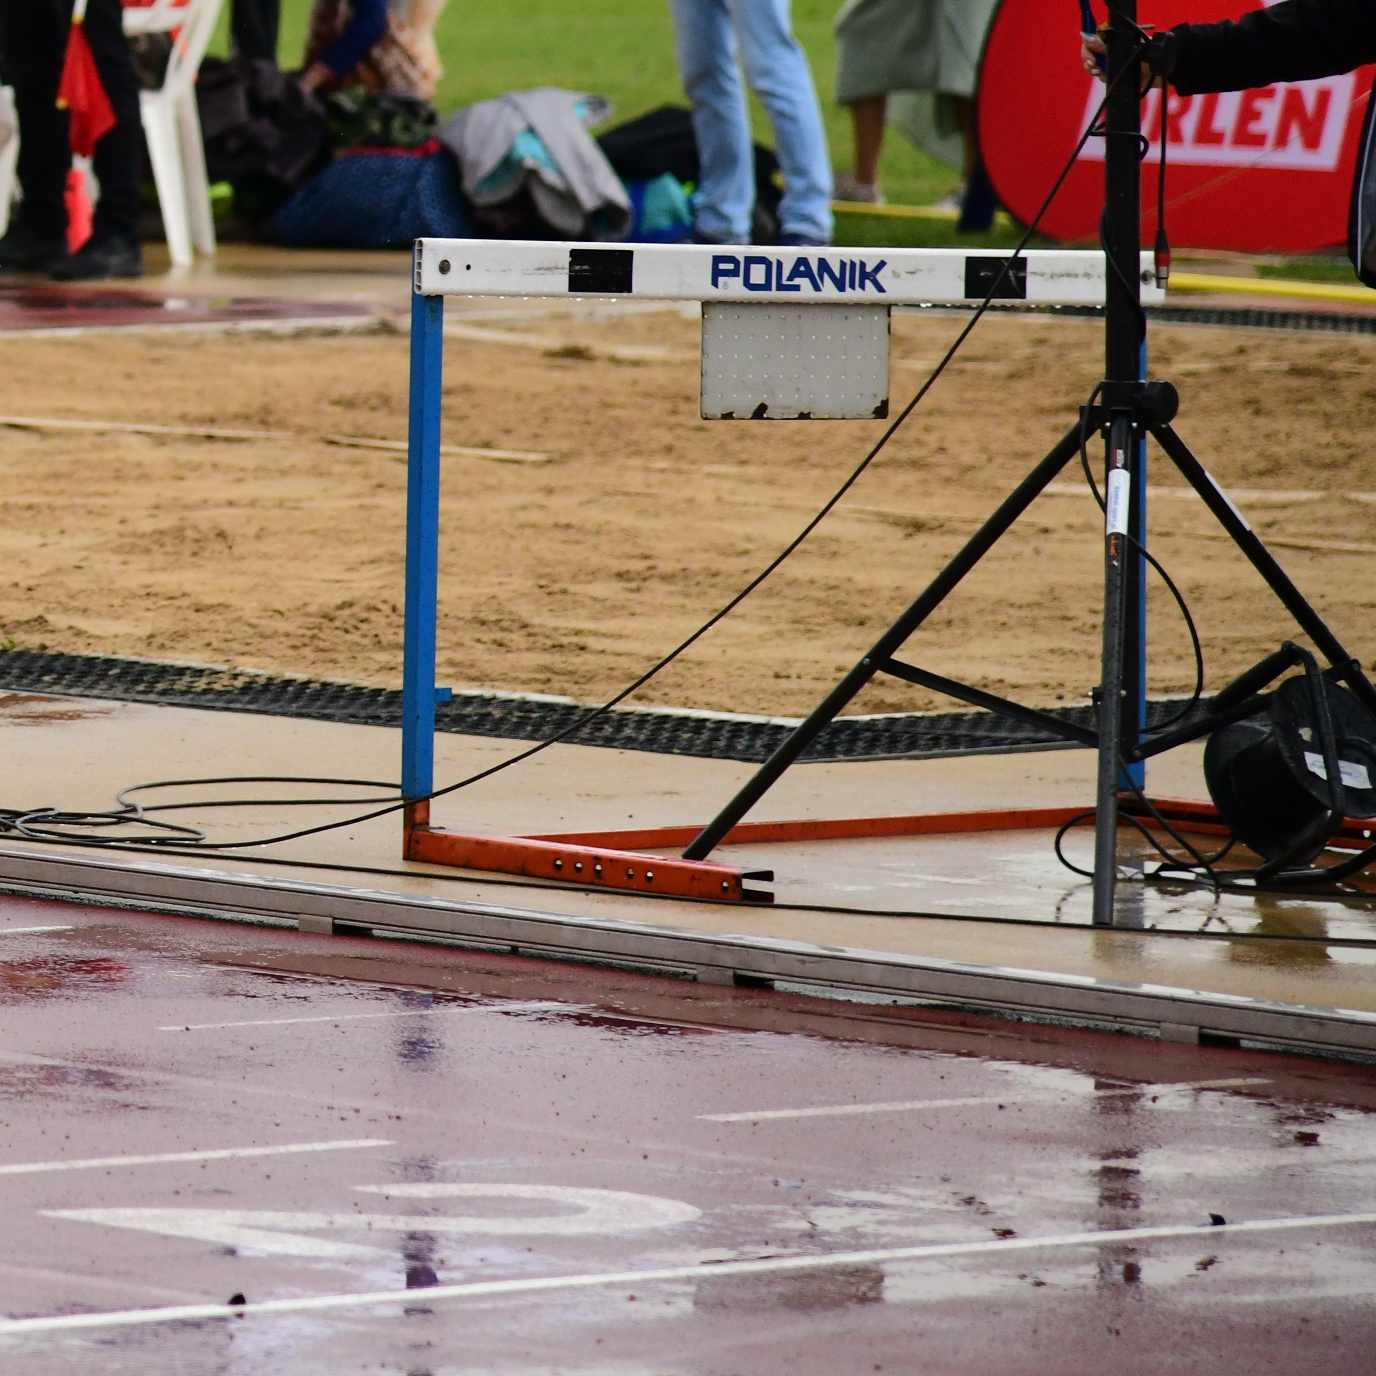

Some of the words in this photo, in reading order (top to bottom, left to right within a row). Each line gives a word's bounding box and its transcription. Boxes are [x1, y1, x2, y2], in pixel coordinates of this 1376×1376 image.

[1099, 85, 1334, 151] RLEN
[710, 254, 888, 294] POLANIK
[39, 1182, 702, 1259] 2
